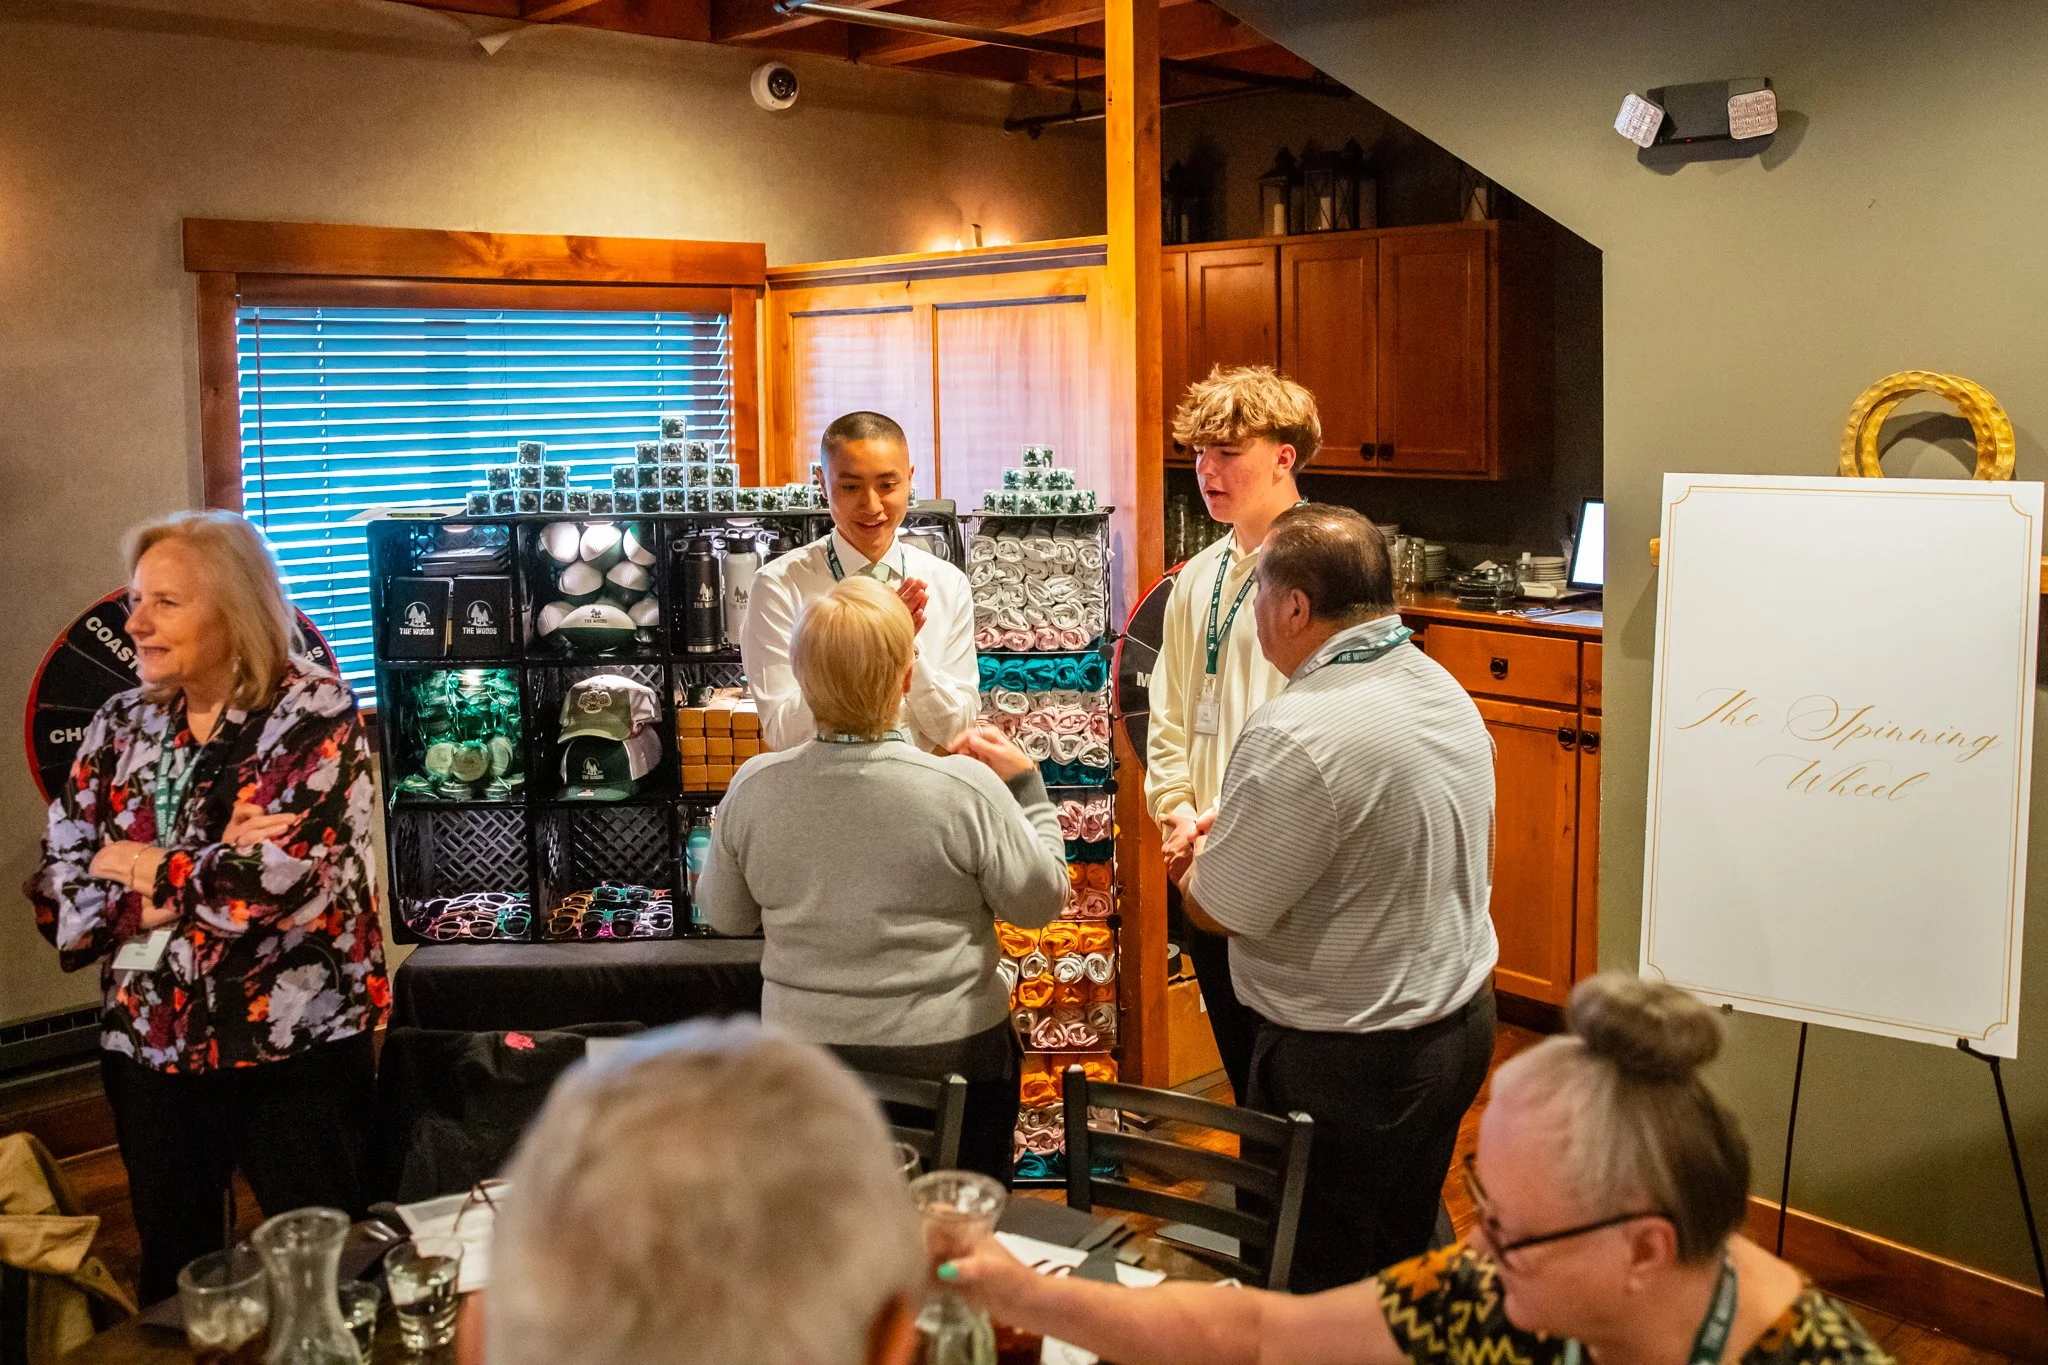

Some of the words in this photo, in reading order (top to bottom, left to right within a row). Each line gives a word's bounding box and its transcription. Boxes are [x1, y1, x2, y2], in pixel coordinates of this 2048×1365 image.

[1209, 607, 1217, 626] WOODS
[399, 627, 412, 636] THE
[412, 628, 435, 636] WOODS
[462, 627, 475, 635] THE
[476, 627, 498, 635] WOODS
[1208, 627, 1216, 639] THE
[1675, 688, 1763, 730] The
[1782, 695, 2003, 763] Spinning
[1755, 754, 1930, 801] Wheel
